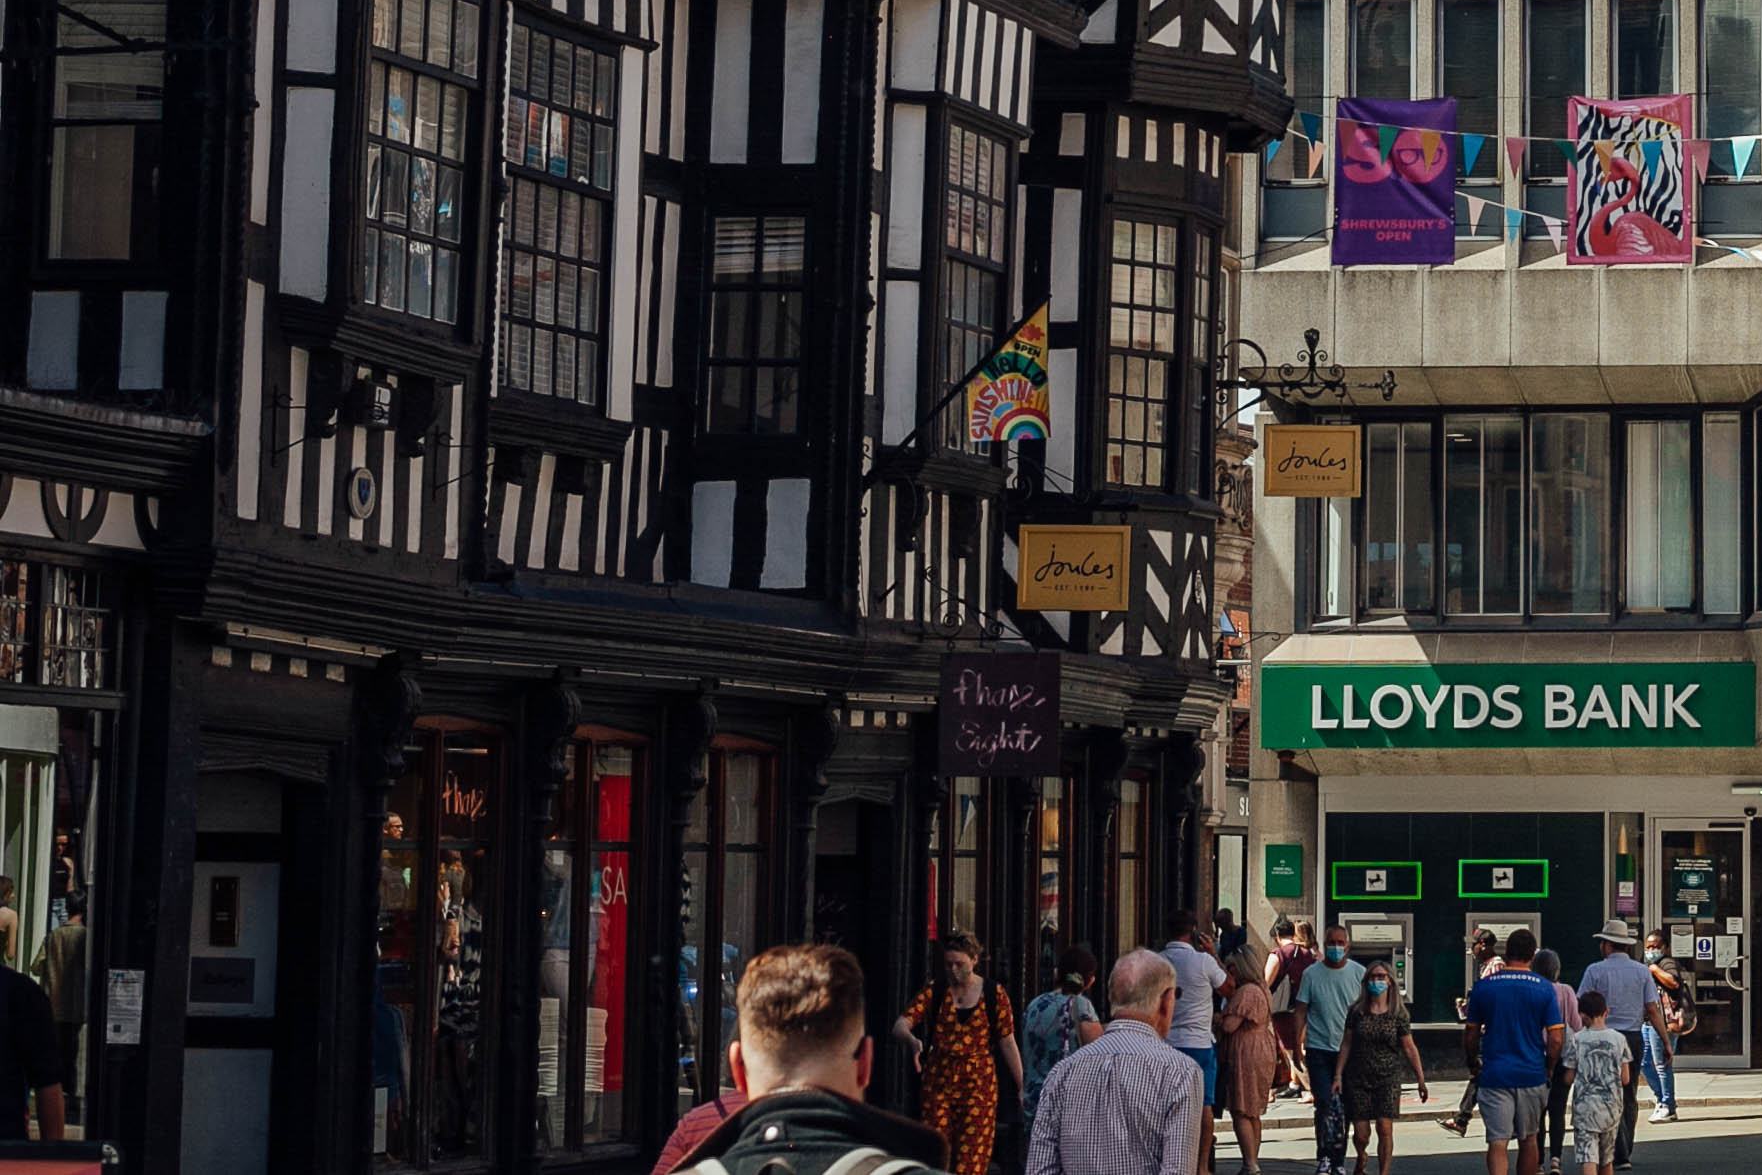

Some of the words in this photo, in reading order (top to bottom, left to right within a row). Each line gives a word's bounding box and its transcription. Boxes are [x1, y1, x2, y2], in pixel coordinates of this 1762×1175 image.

[1341, 218, 1447, 231] SHREWSBURY'S
[1375, 230, 1412, 242] OPEN
[1013, 343, 1042, 358] OPEN
[1311, 684, 1523, 729] LLOYDS
[1544, 684, 1702, 729] BANK
